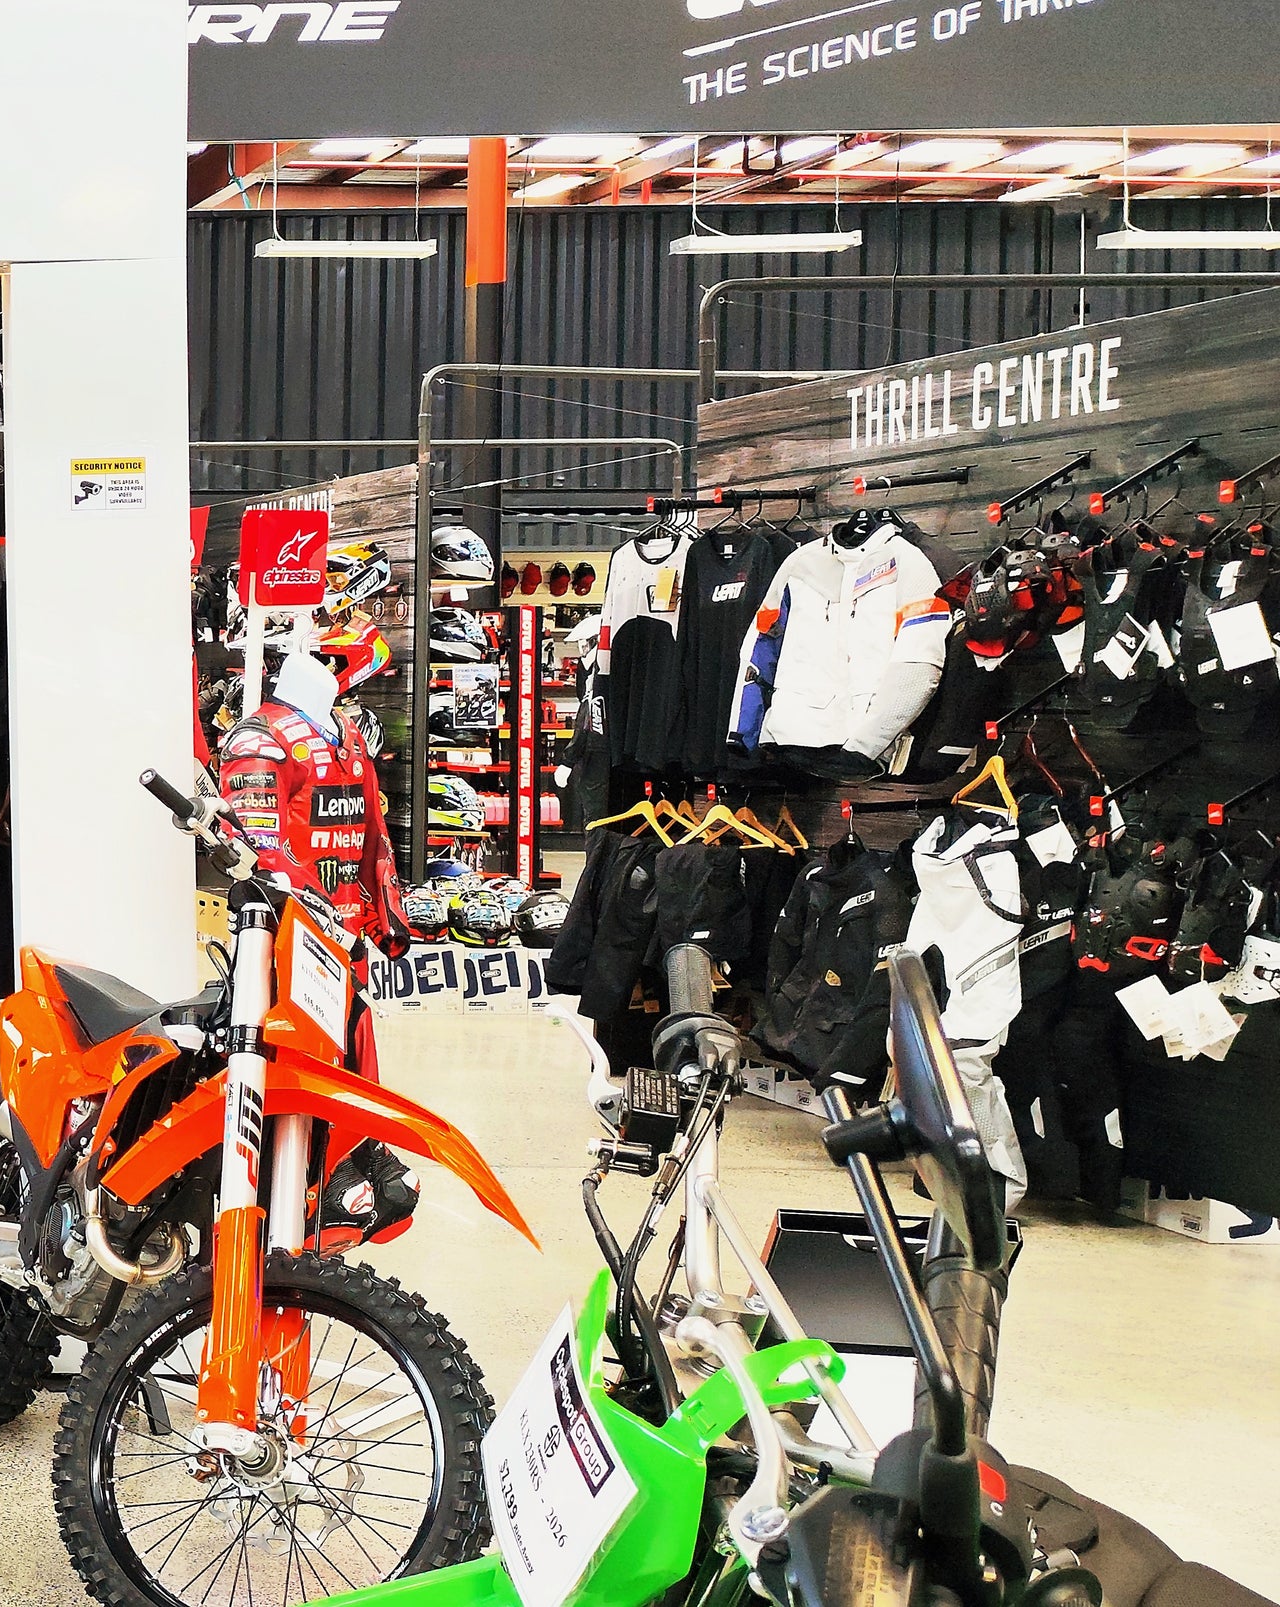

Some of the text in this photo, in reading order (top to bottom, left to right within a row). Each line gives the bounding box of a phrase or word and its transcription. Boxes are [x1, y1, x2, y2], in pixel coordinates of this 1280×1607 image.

[188, 1, 401, 44] RNE
[682, 62, 747, 104] THE
[762, 17, 918, 85] SCIENCE
[933, 1, 982, 41] OF
[846, 336, 1122, 450] THRILL CENTRE
[74, 462, 142, 471] SECURITY NOTICE
[263, 566, 321, 587] alpinestars
[521, 609, 532, 650] MOTUL
[521, 653, 532, 695] MOTUL
[521, 698, 532, 739] MOTUL
[520, 747, 530, 789] MOTUL
[318, 794, 365, 817] Lenovo
[520, 795, 530, 837] MOTUL
[1023, 931, 1050, 949] LEATT
[371, 951, 459, 1001] SHOEI
[554, 1347, 603, 1478] Cyclespot Group
[545, 1507, 569, 1548] 2026
